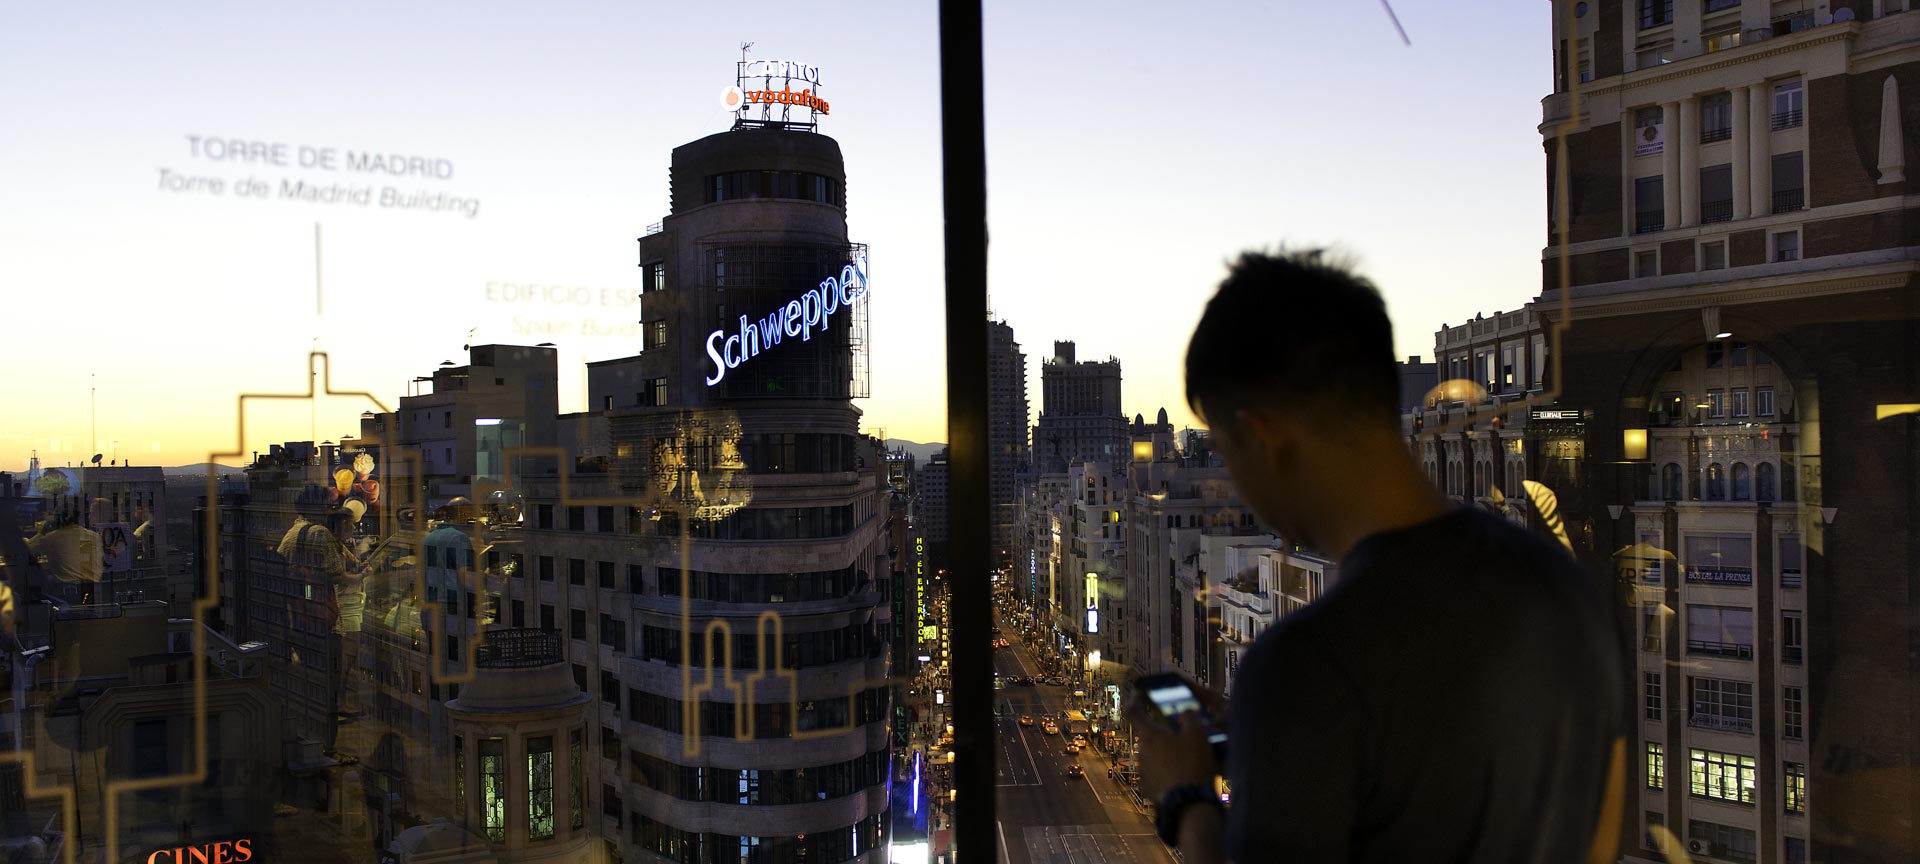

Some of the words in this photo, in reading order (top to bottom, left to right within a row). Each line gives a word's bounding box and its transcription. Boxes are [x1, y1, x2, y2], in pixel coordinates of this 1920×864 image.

[746, 60, 821, 86] CAPITOL
[748, 85, 829, 115] vodafone
[186, 134, 289, 166] TORRE
[298, 145, 338, 171] DE
[346, 149, 455, 180] MADRID
[155, 167, 225, 195] Torre
[234, 174, 271, 198] de
[278, 177, 372, 207] Madrid
[380, 185, 481, 218] Building
[485, 280, 591, 306] EDIFICIO
[706, 256, 868, 387] Schweppes
[1688, 571, 1714, 580] HOSTAL
[1714, 572, 1724, 581] LA
[1725, 573, 1752, 583] PRENSA
[894, 573, 905, 638] HOTEL
[916, 578, 925, 644] EMPERADOR
[895, 706, 906, 743] REX
[147, 838, 253, 864] CINES
